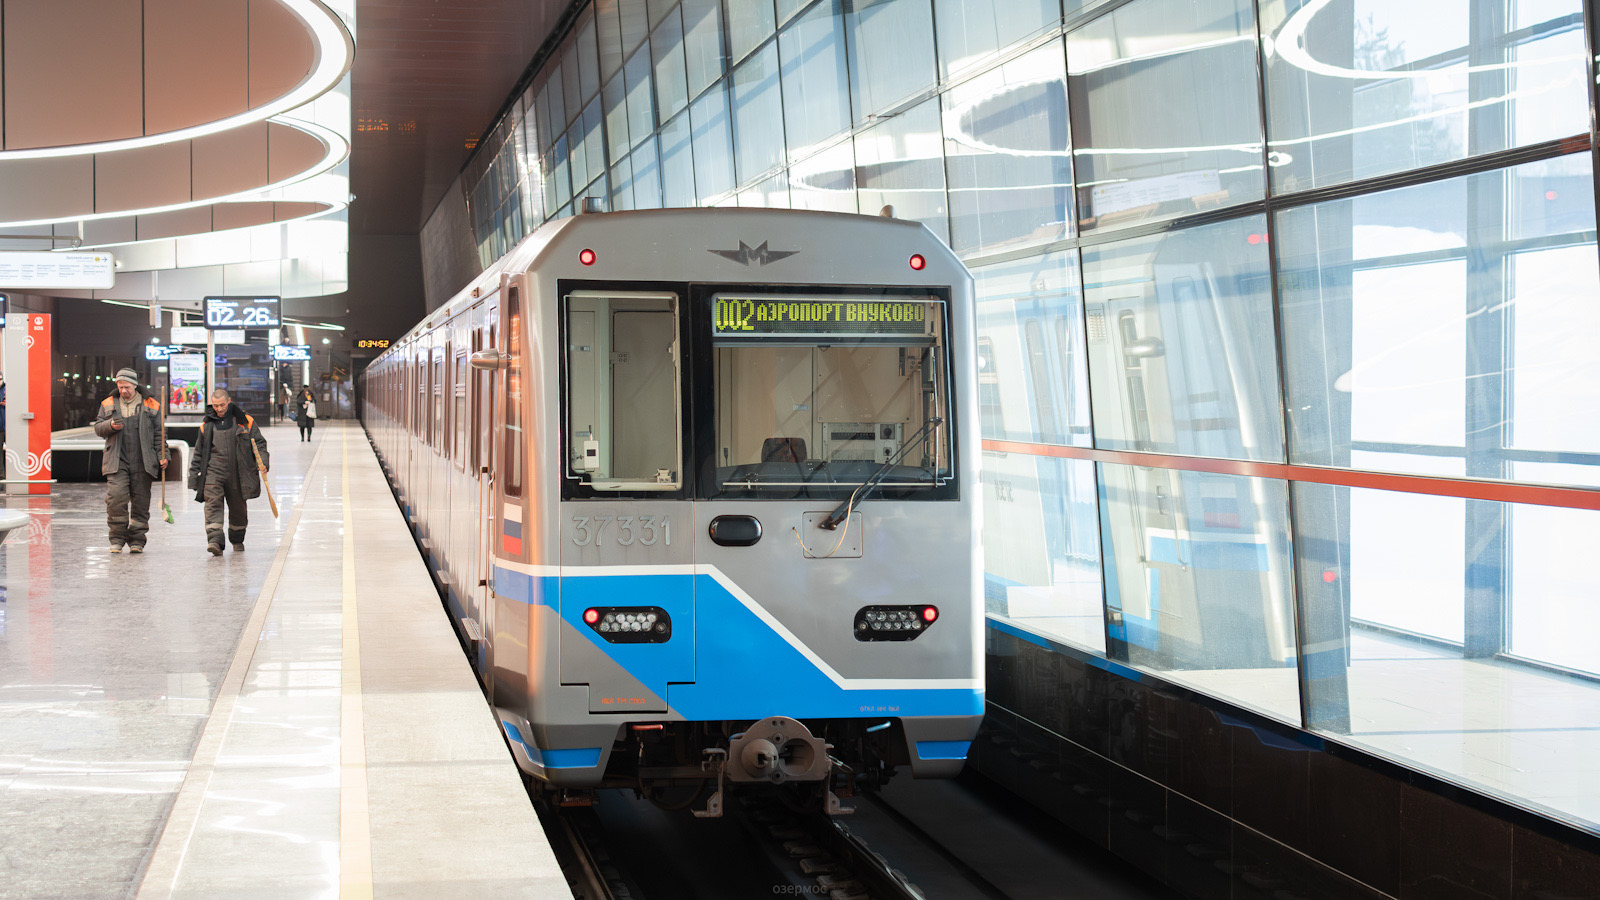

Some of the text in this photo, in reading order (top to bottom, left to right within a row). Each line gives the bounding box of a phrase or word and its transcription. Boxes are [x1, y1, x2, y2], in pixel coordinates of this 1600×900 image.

[207, 307, 234, 326] 02
[242, 307, 270, 326] 26
[715, 299, 925, 331] 002 АЭРОПОРТ ВНУКОВО
[358, 340, 389, 348] 10:34:52
[571, 515, 671, 546] 37331
